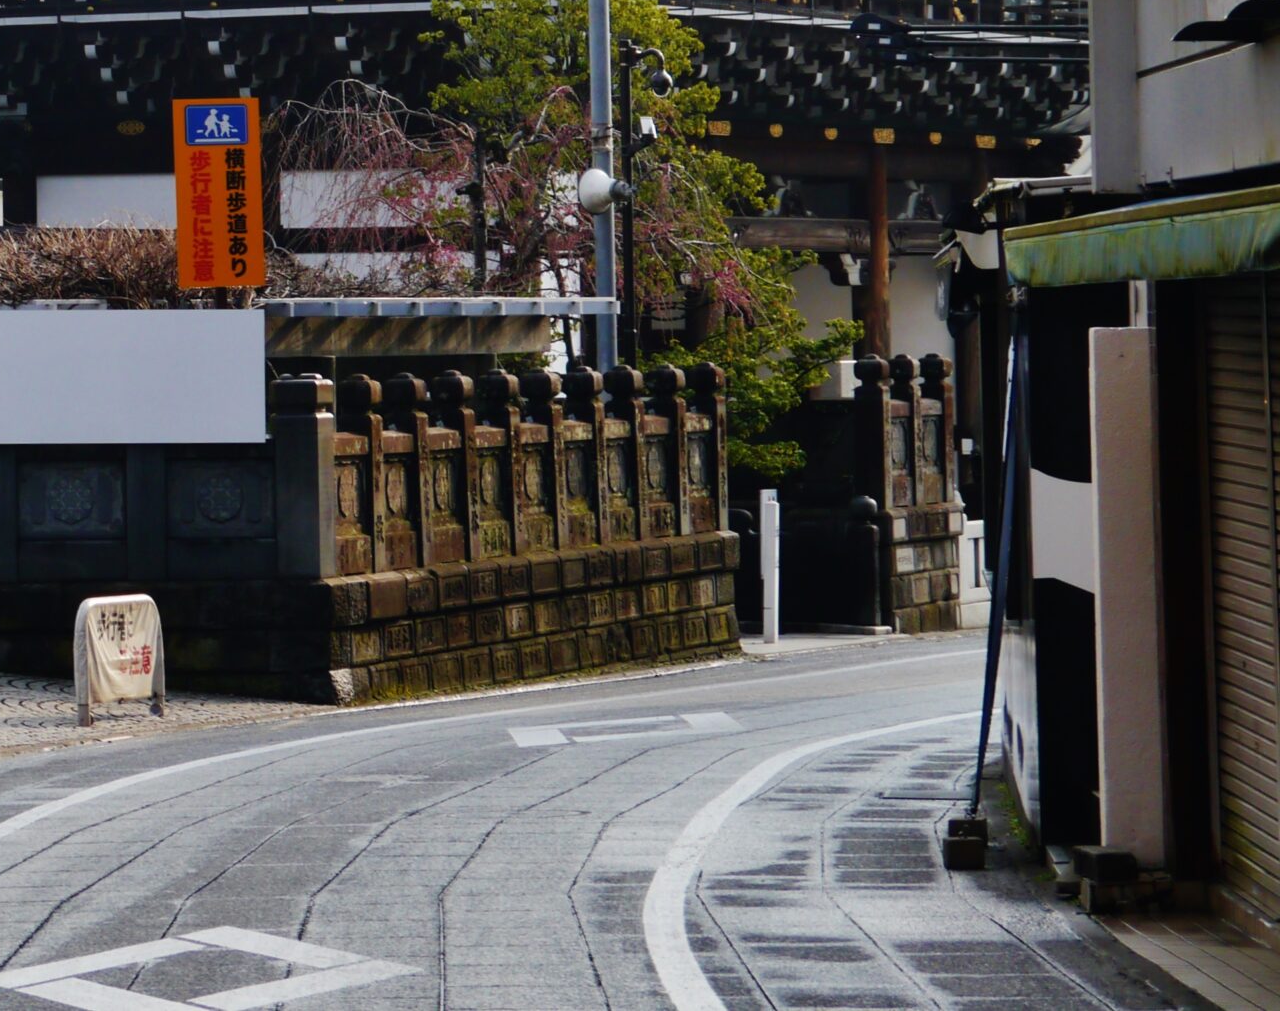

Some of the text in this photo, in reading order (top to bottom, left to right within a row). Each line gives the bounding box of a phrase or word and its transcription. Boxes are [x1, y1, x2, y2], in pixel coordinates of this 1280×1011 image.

[190, 150, 215, 283] 歩行者に注意
[225, 148, 249, 278] 横断歩道あり
